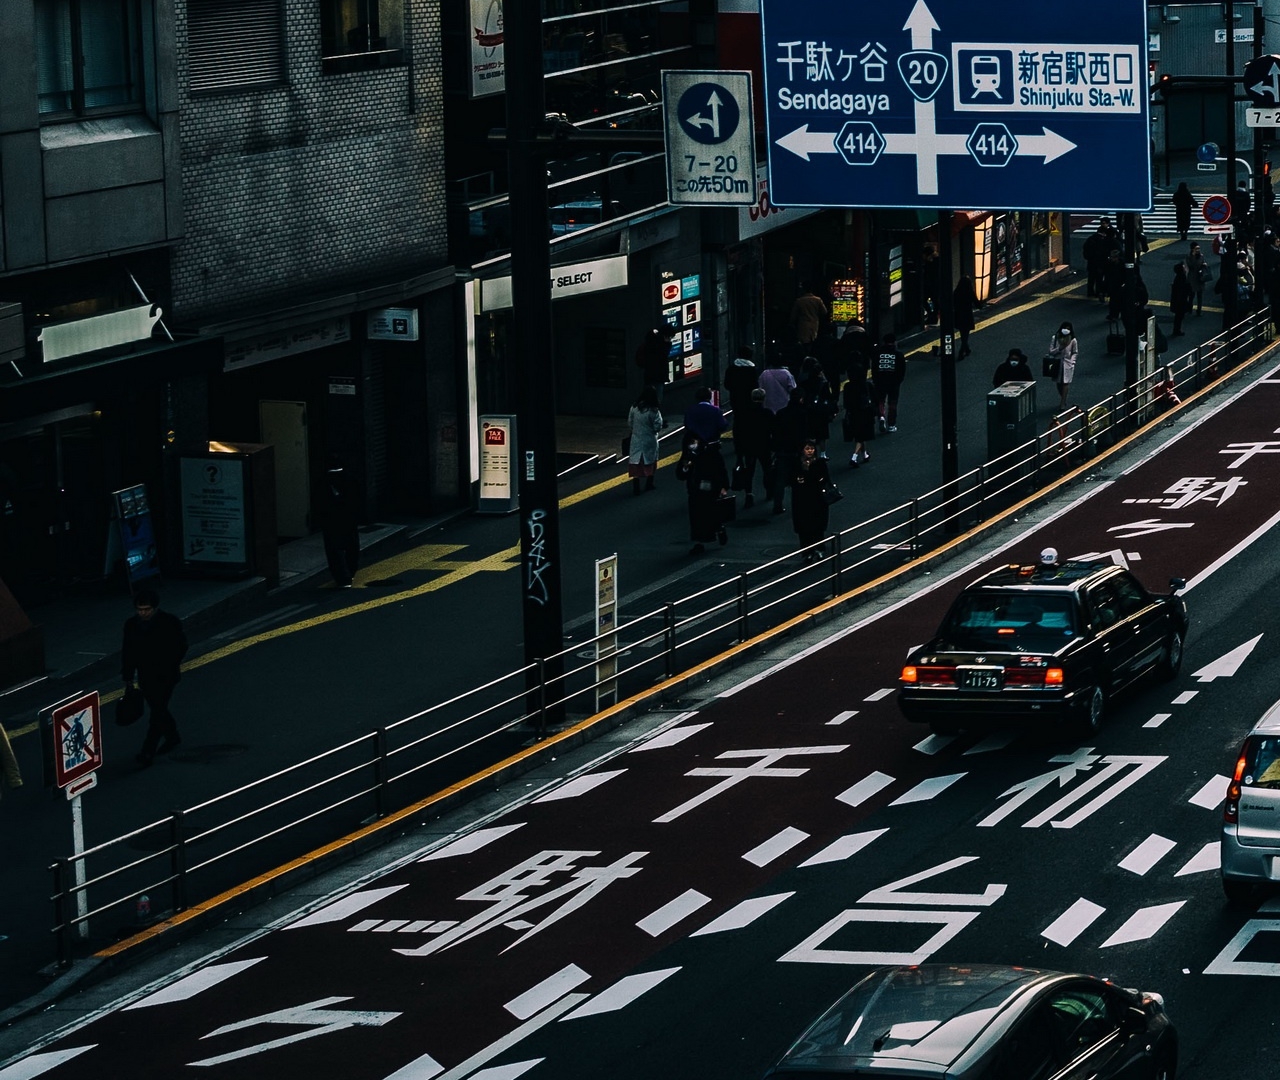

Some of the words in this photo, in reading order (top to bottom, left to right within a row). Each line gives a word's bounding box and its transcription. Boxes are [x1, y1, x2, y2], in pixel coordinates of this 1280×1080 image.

[908, 59, 938, 86] 20
[1018, 50, 1133, 86] 新宿駅西口
[778, 87, 890, 115] Sendagaya
[1019, 87, 1084, 107] Shinjuku
[843, 133, 877, 155] 414
[976, 134, 1010, 156] 414
[676, 175, 749, 195] この先50m
[557, 272, 593, 288] SELECT
